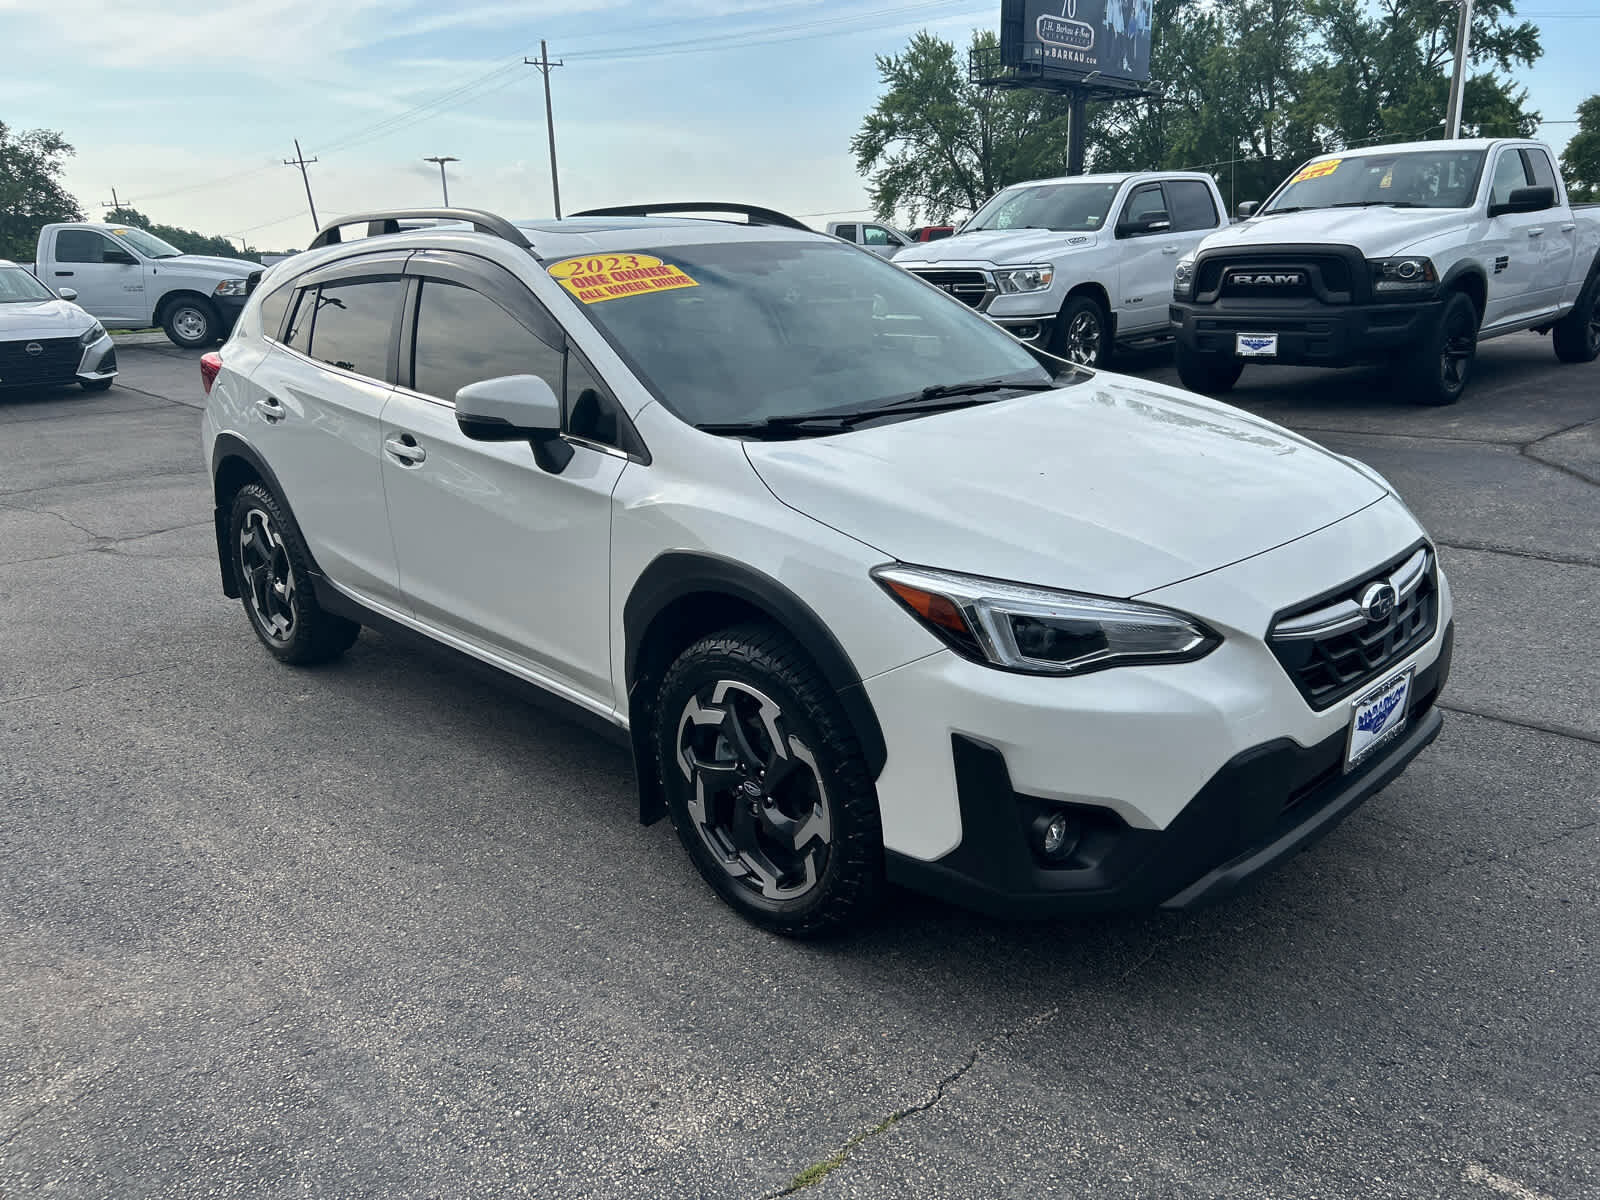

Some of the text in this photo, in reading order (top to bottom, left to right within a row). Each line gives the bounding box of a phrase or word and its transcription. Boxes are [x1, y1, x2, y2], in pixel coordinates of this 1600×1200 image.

[568, 256, 640, 276] 2023
[570, 265, 672, 289] ONE OWNER
[579, 275, 691, 301] ALL WHEEL DRIVE
[1233, 275, 1299, 284] RAM
